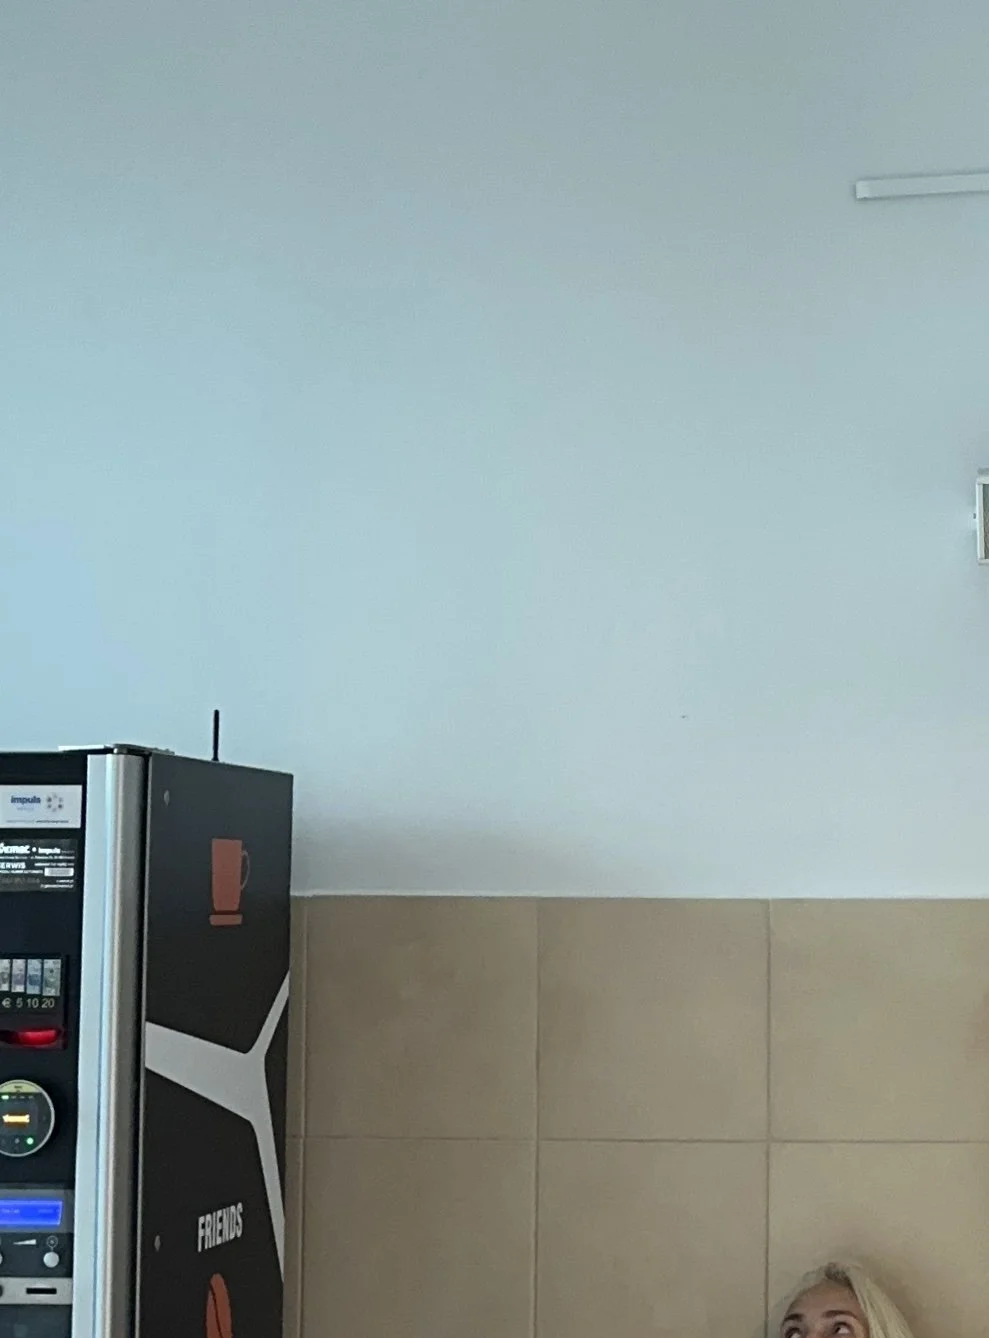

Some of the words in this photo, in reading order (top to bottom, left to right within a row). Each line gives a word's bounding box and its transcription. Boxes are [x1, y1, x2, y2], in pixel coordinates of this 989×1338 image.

[16, 997, 23, 1008] 5
[27, 997, 39, 1008] 10
[41, 998, 55, 1008] 20
[198, 1202, 243, 1252] FRIENDS
